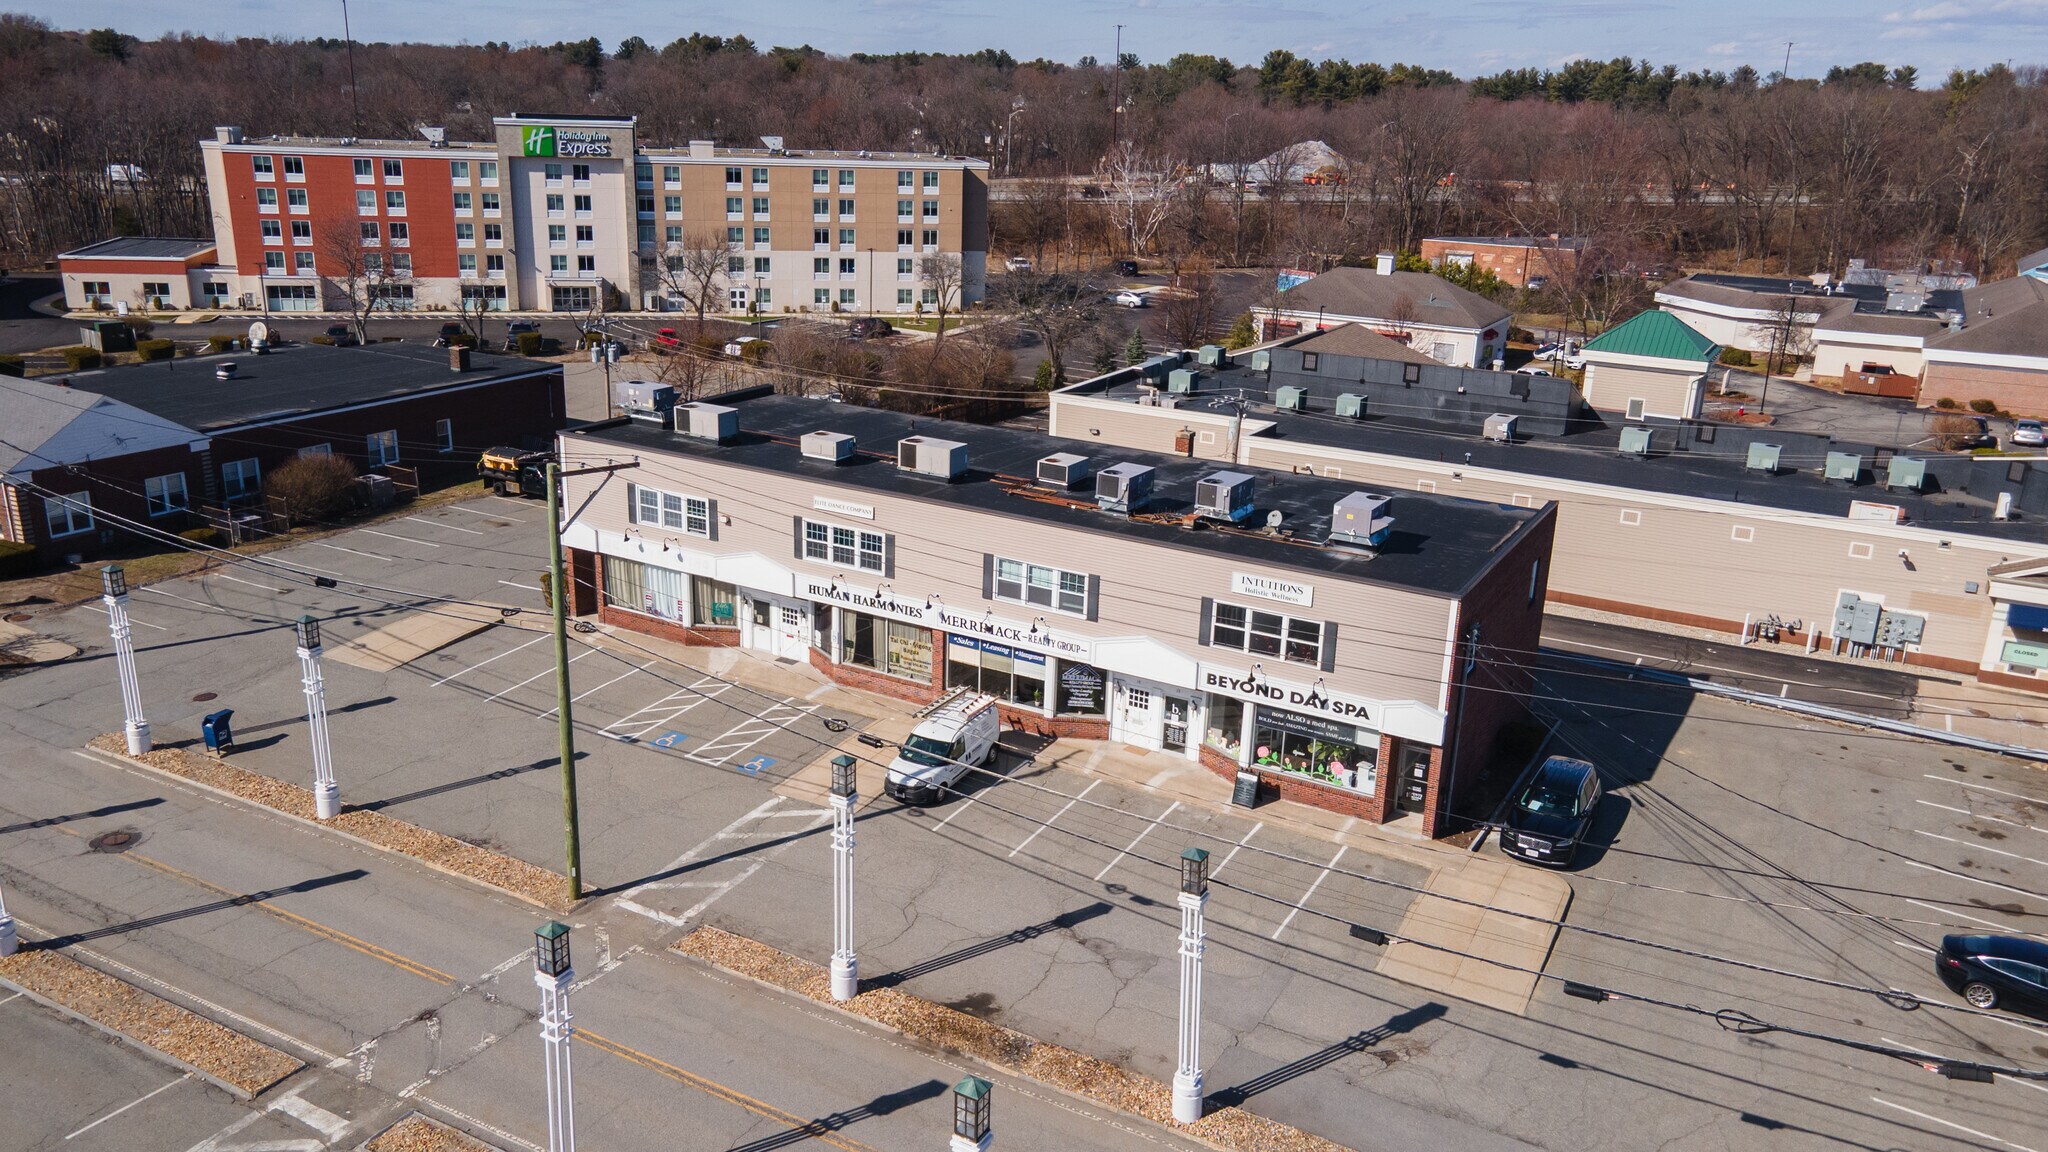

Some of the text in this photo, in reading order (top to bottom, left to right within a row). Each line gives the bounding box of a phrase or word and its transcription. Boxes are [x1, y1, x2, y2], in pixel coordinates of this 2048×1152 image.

[558, 131, 607, 142] Holiday Inn
[558, 141, 608, 157] Express
[827, 502, 845, 510] DANCE
[846, 505, 872, 515] COMPANY
[1241, 576, 1304, 595] INTUITIONS
[808, 584, 923, 618] HUMAN HARMONIES
[1244, 587, 1299, 603] Holistic Wellness
[956, 636, 975, 648] Sales
[986, 643, 1010, 656] Leasing
[1027, 633, 1056, 649] REALTY
[1056, 640, 1081, 654] GROUP
[2014, 649, 2039, 657] CLOSED
[1206, 672, 1370, 721] BEYOND DAY SPA
[1271, 711, 1285, 719] now
[1285, 713, 1306, 724] ALSO
[1311, 720, 1326, 729] med
[1327, 724, 1340, 733] spa.
